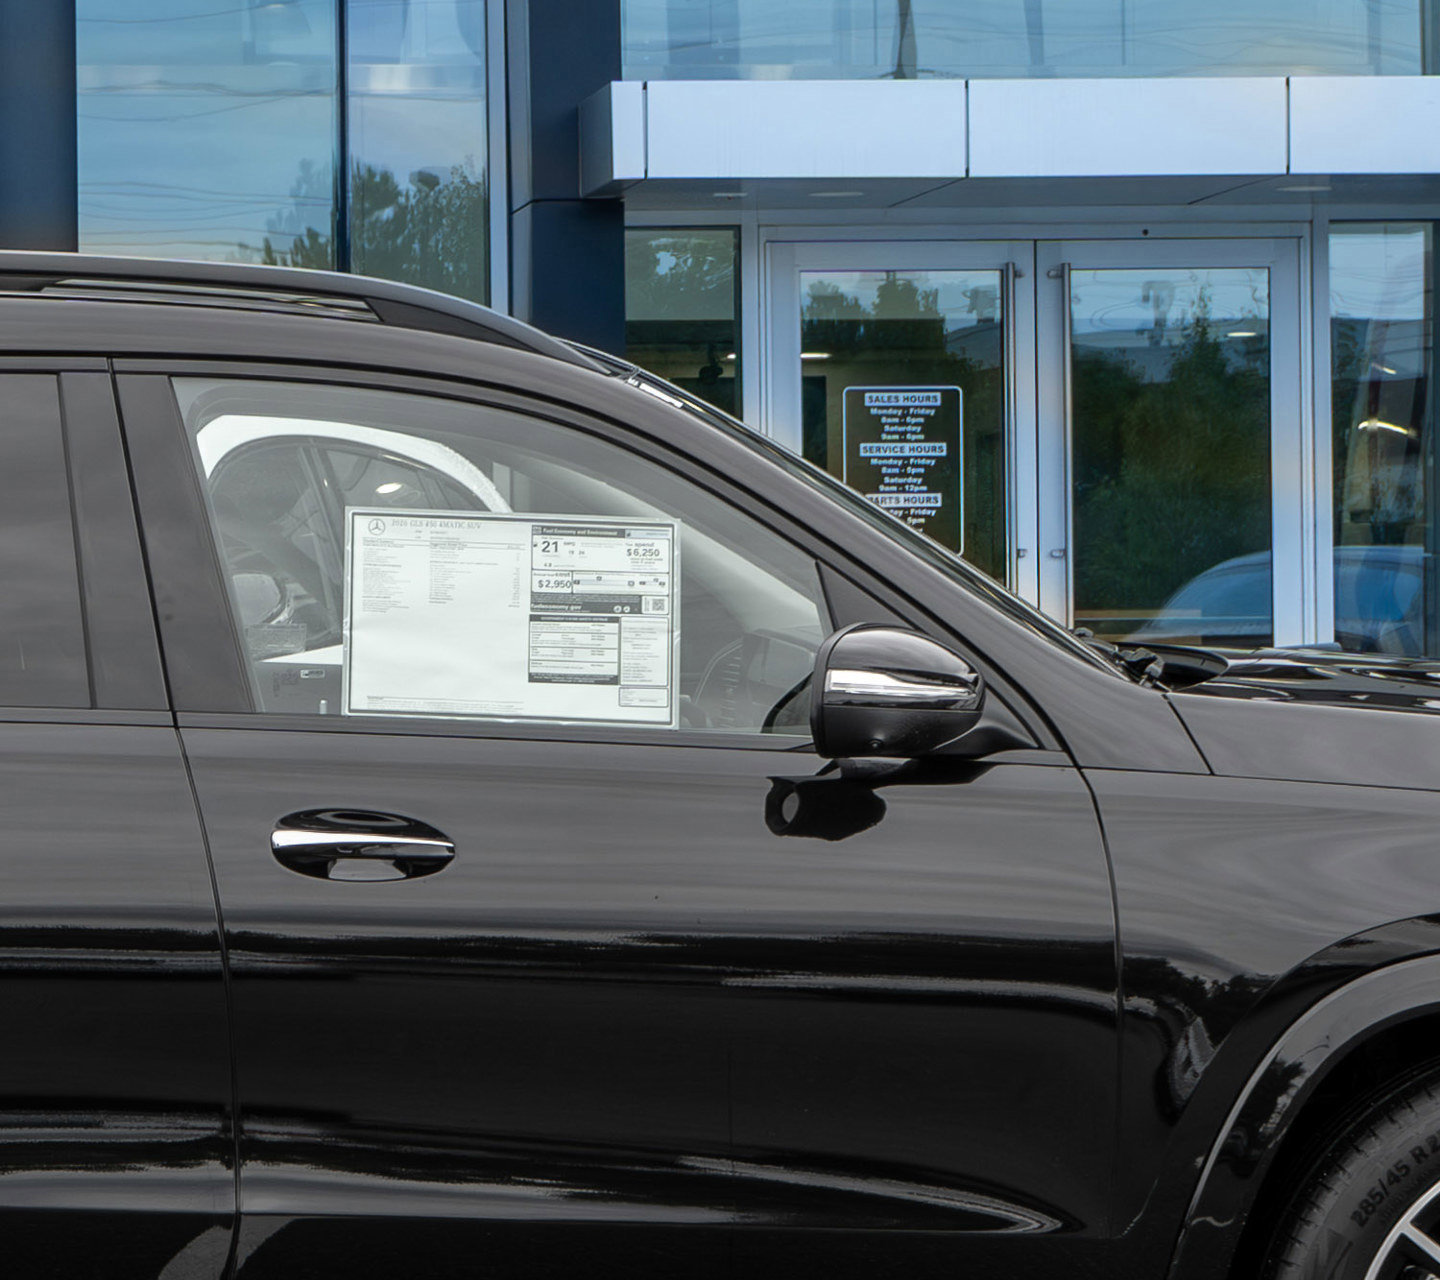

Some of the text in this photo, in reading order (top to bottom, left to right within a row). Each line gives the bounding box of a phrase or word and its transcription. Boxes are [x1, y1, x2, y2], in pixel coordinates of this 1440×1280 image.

[867, 394, 938, 404] SALES HOURS
[870, 407, 903, 416] Monday
[909, 407, 936, 416] Friday
[883, 424, 922, 433] Saturday
[862, 445, 944, 454] SERVICE HOURS
[870, 458, 903, 466] Monday
[909, 458, 936, 466] Friday
[883, 476, 923, 485] Saturday
[903, 496, 939, 505] HOURS
[909, 508, 937, 517] Friday
[541, 540, 559, 553] 21
[626, 548, 661, 558] $6,250
[537, 579, 572, 589] $2,950
[1347, 1157, 1413, 1229] 285/45
[1407, 1142, 1430, 1166] R
